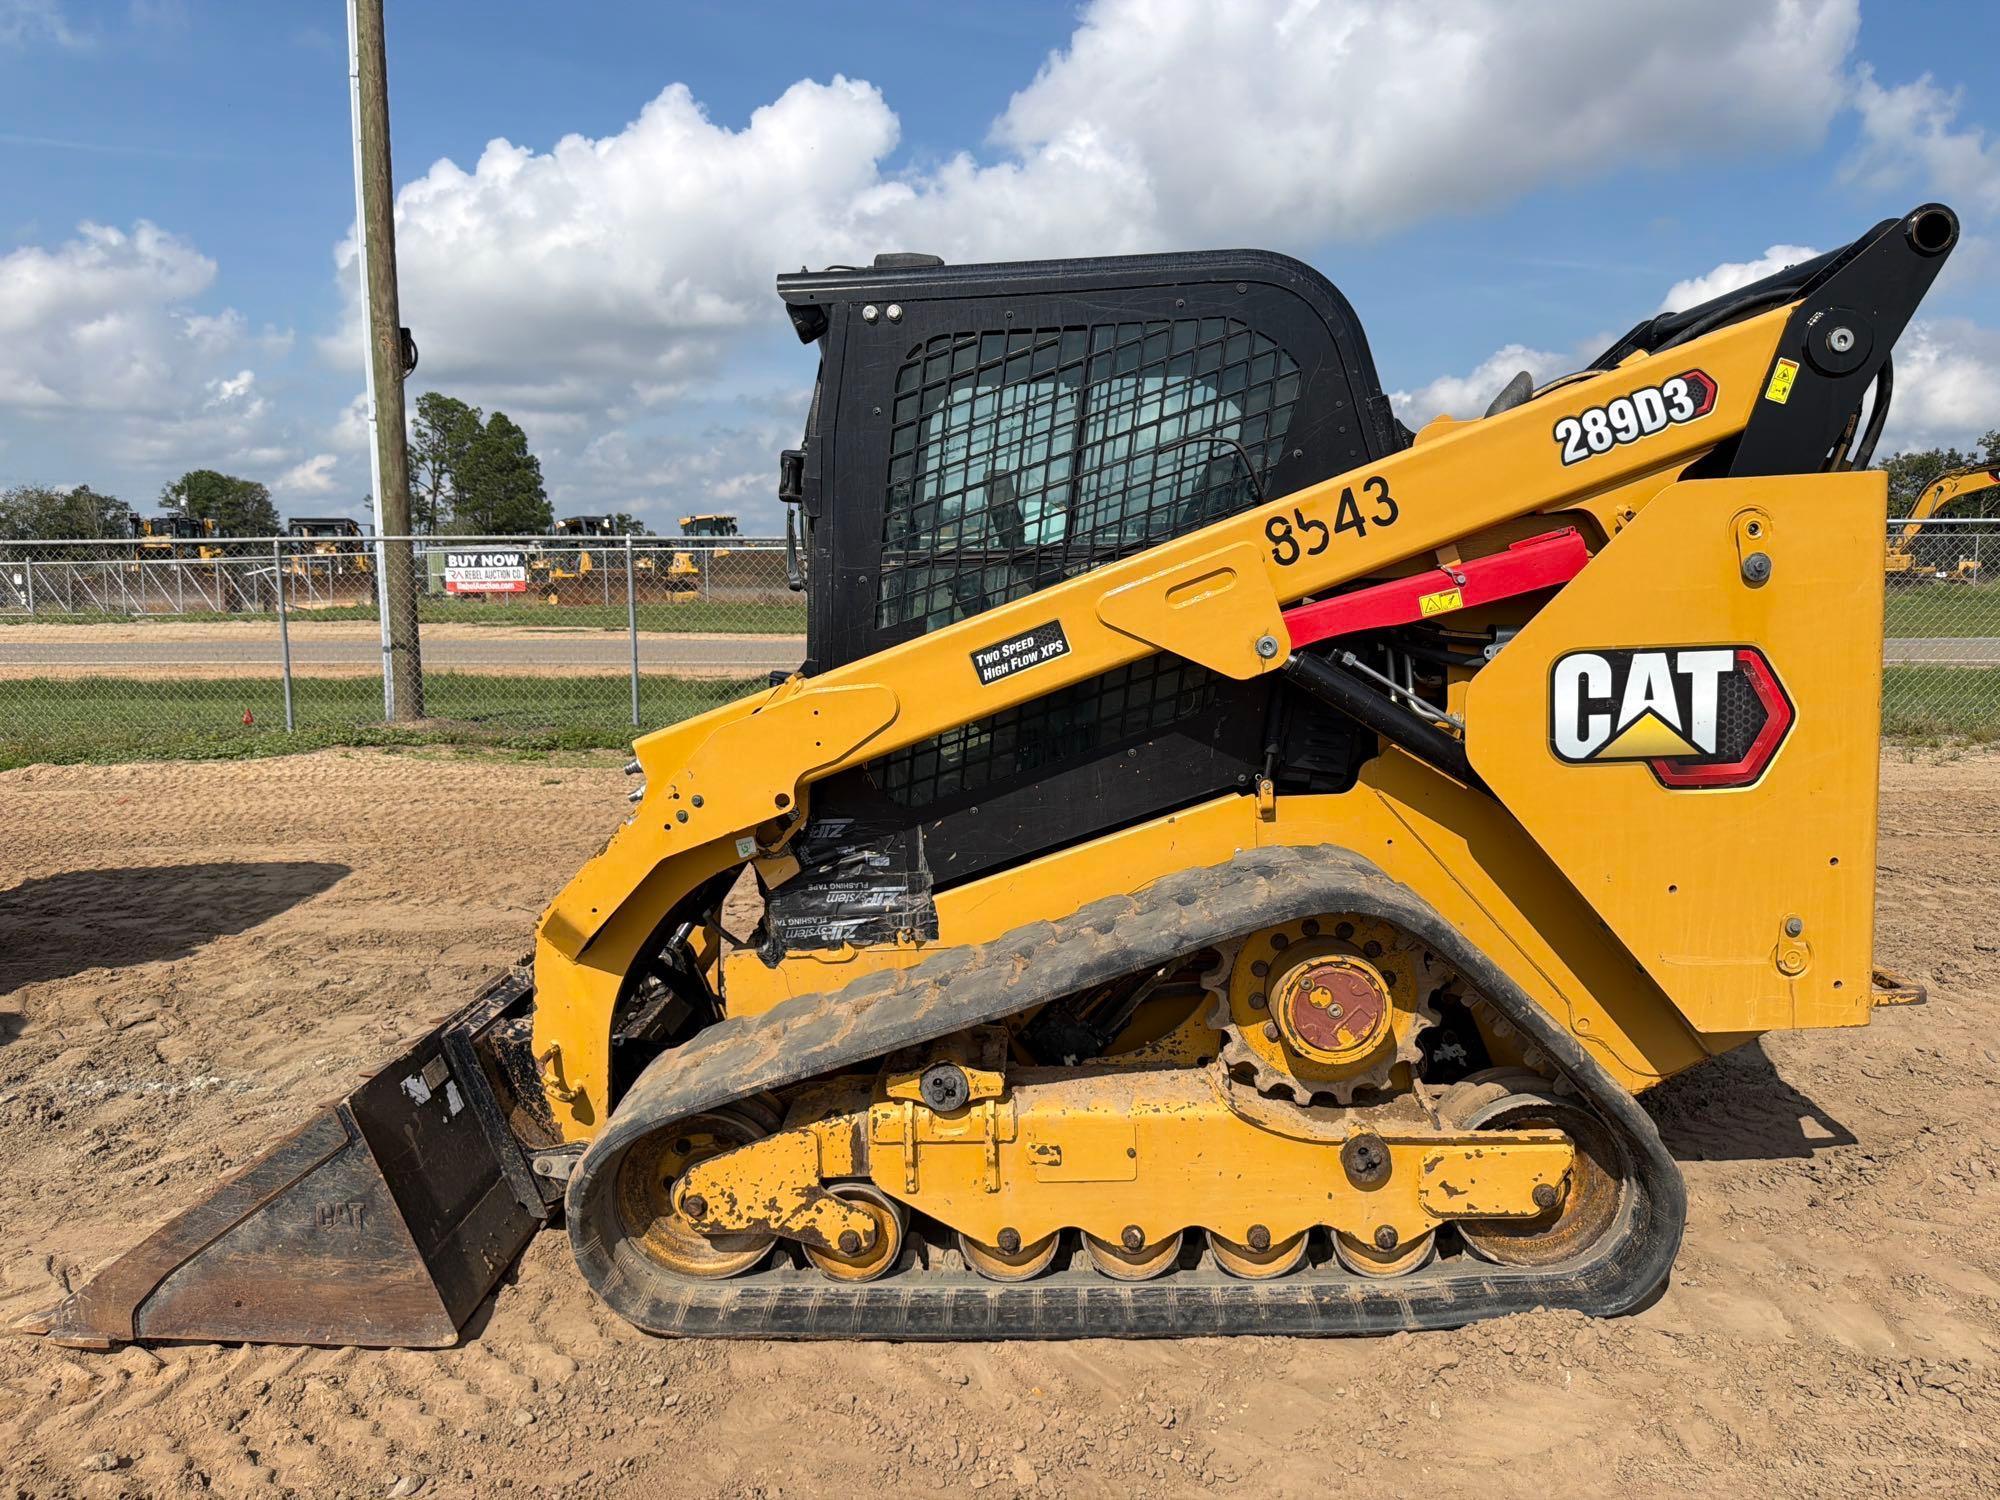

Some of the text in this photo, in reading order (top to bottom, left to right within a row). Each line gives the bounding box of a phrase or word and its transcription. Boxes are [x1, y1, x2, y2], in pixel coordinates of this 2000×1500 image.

[1555, 378, 1695, 463] 289D3
[1265, 475, 1399, 566] 8543
[448, 554, 519, 567] BUY NOW
[464, 569, 483, 580] REBEL
[484, 569, 511, 580] AUCTION
[1040, 639, 1064, 659] XPS
[1554, 649, 1734, 759] CAT
[807, 882, 869, 891] FLASHING TAPE
[787, 915, 828, 926] FLASHING
